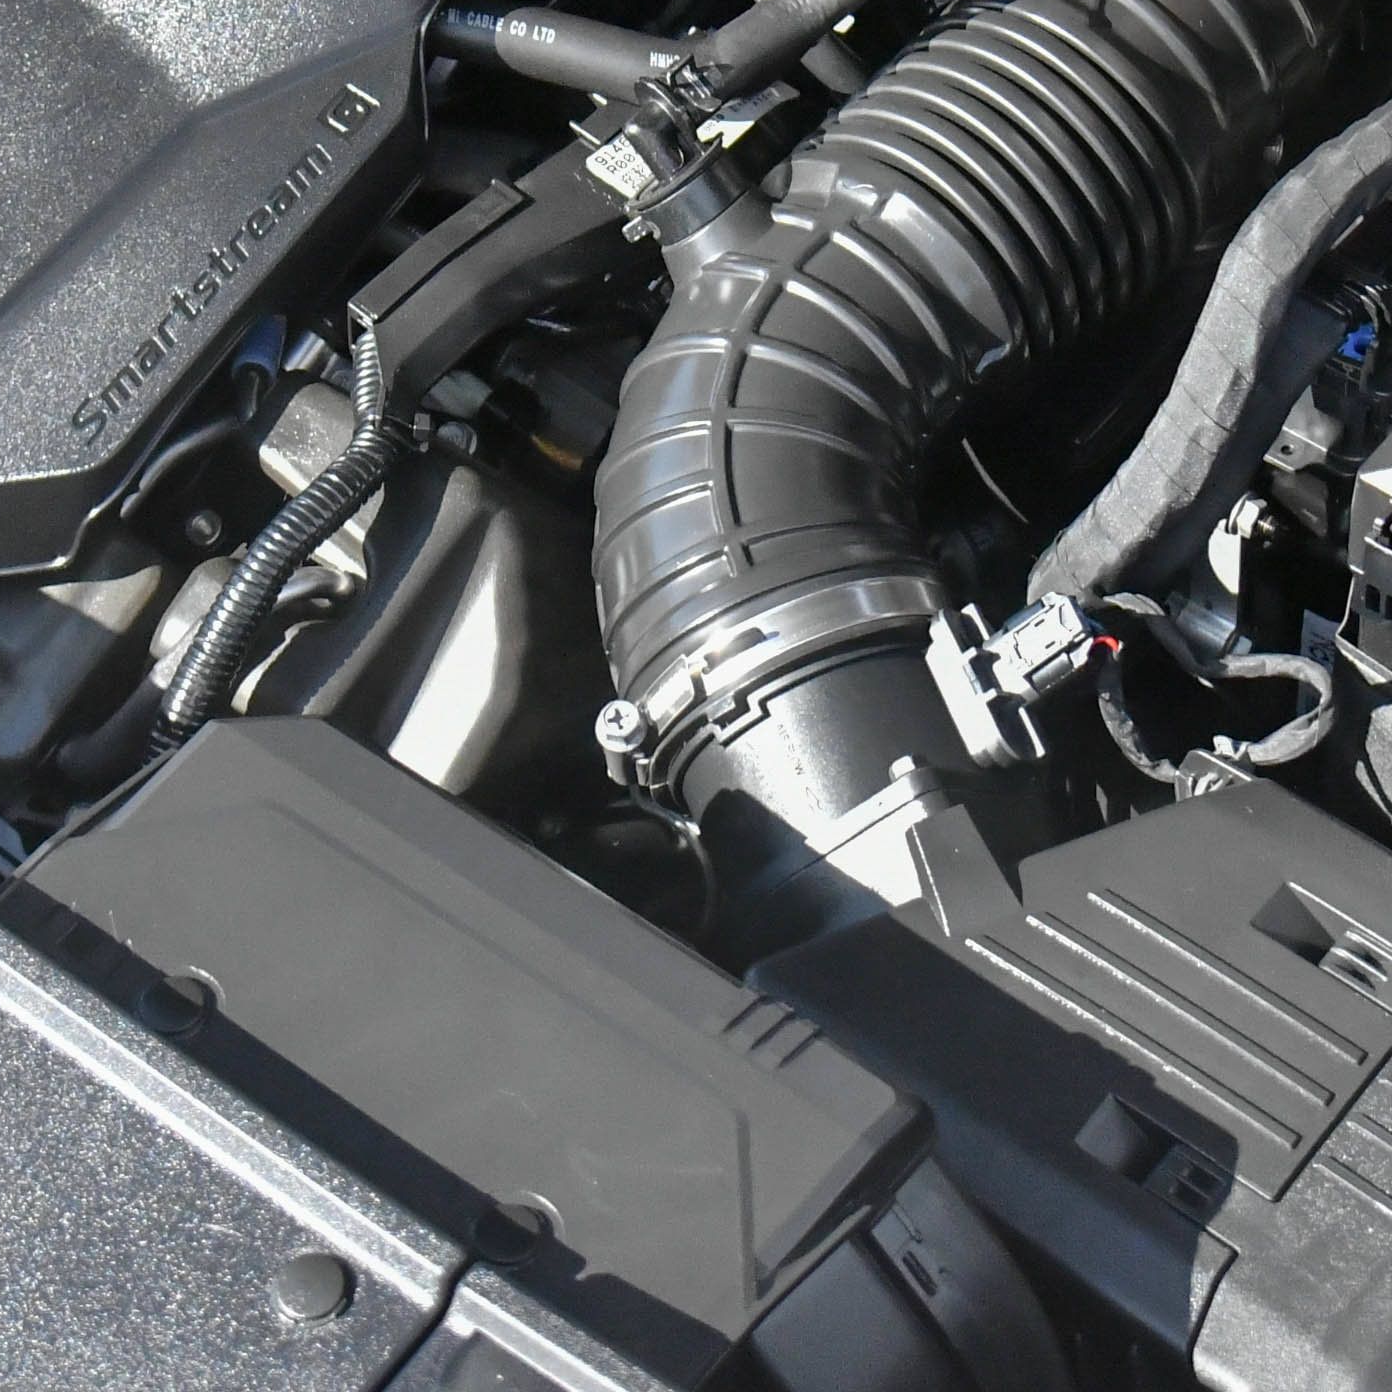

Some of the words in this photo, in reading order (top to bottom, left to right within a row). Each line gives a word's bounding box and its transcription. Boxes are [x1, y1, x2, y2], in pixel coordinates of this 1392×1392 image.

[467, 11, 505, 32] CABLE
[509, 20, 527, 37] CO
[532, 25, 556, 44] LTD
[72, 143, 332, 446] Smartstream
